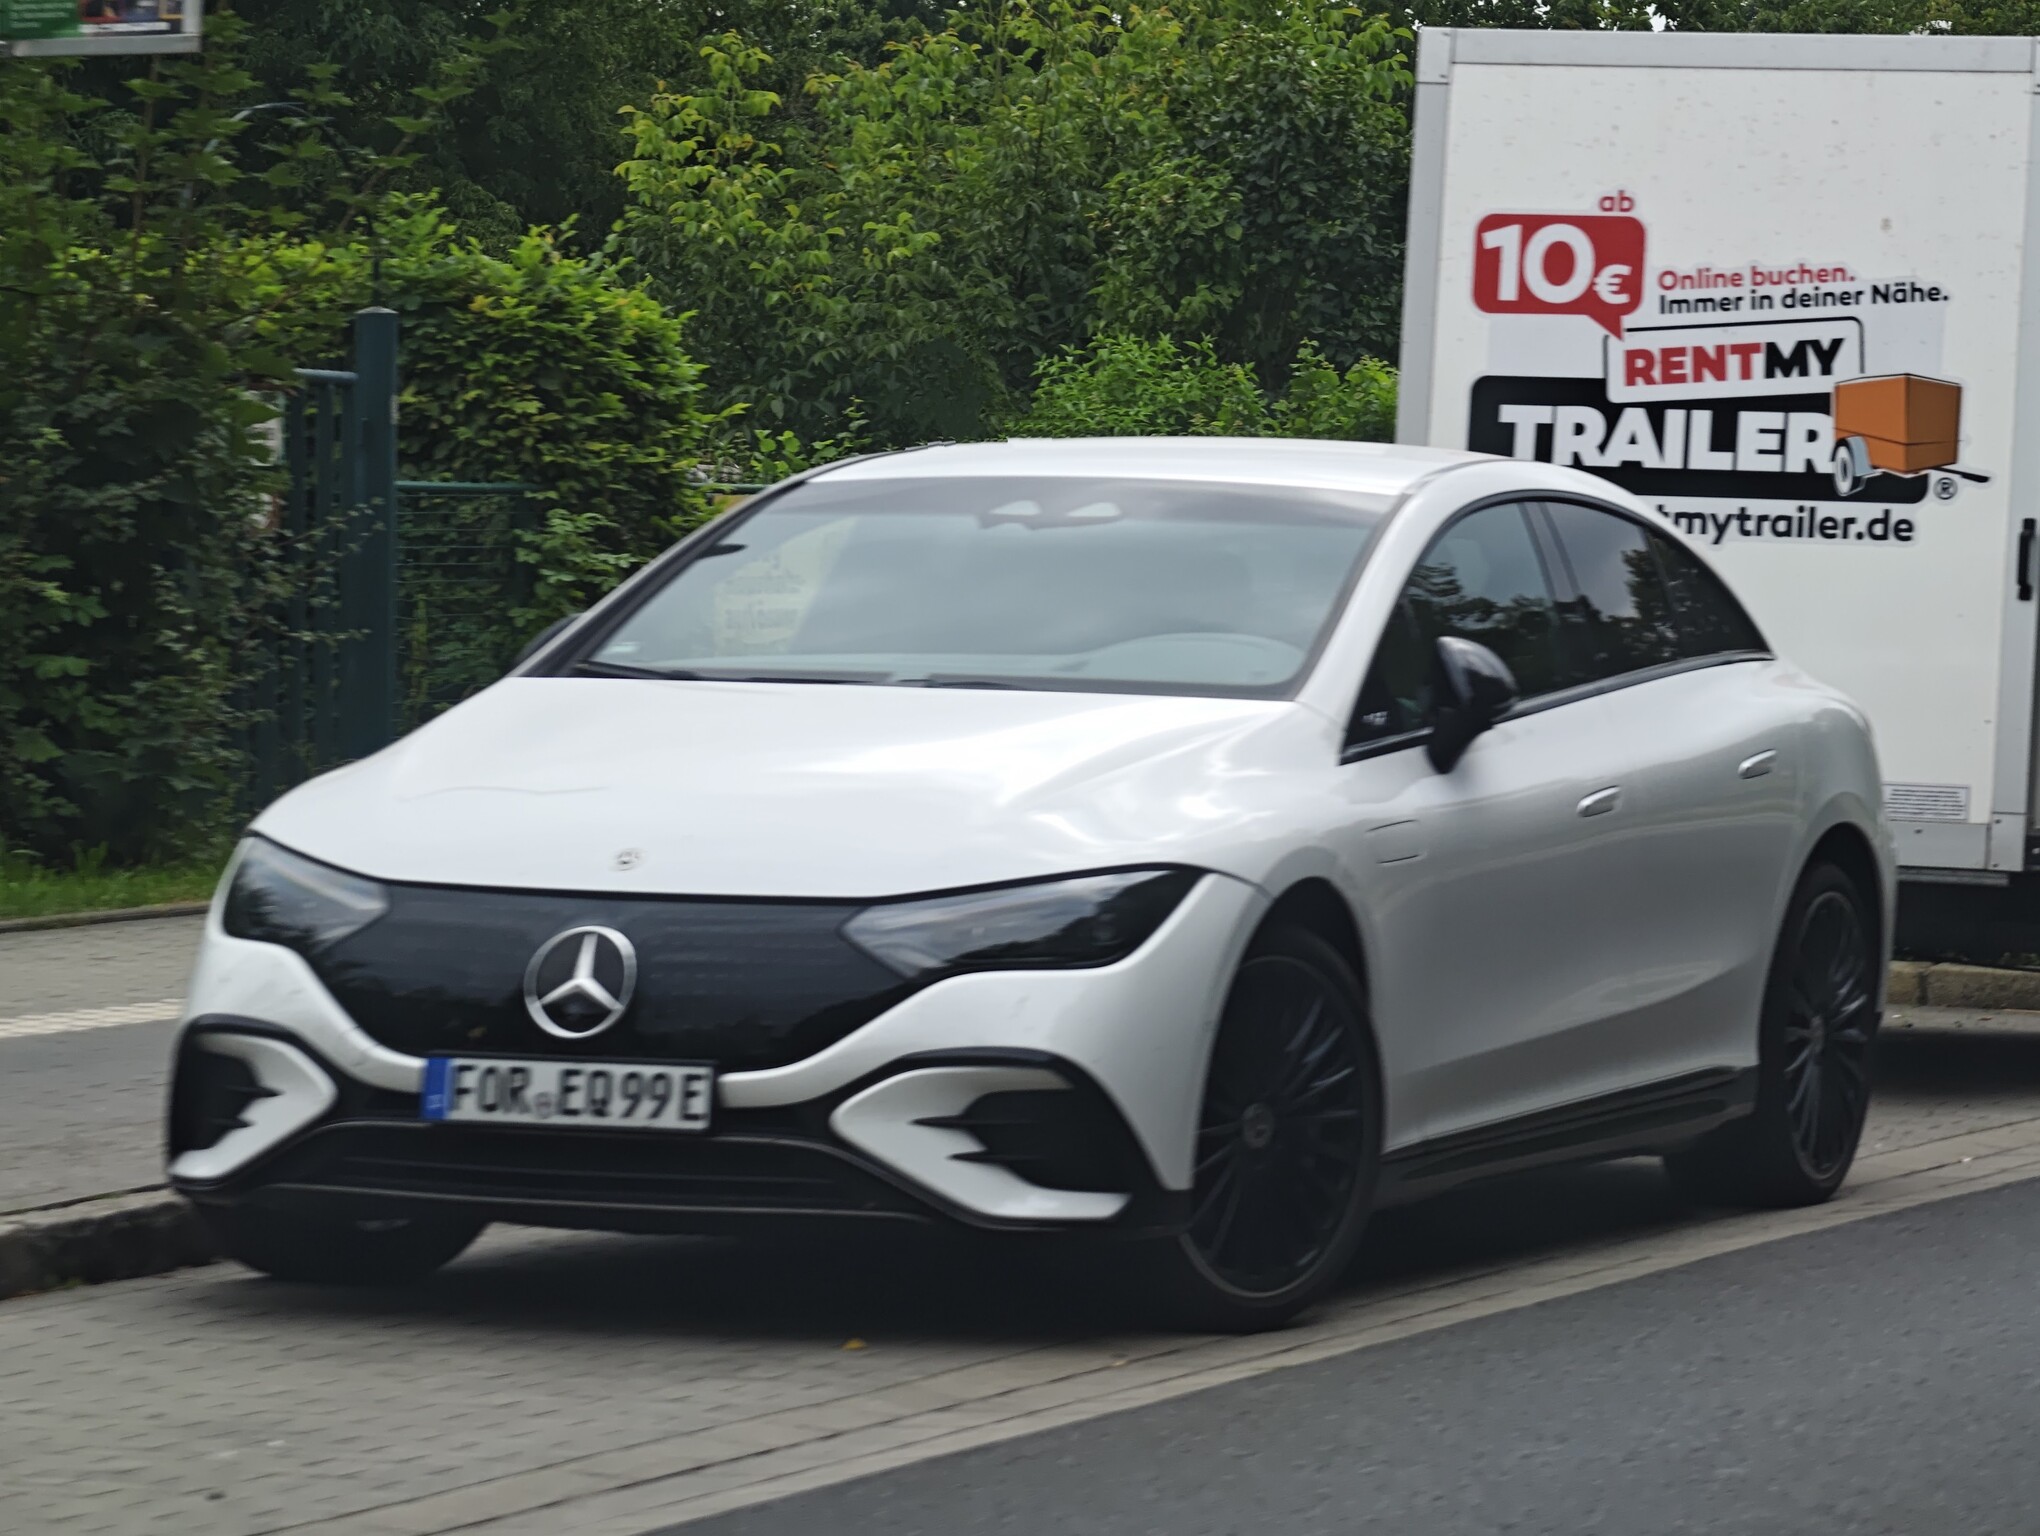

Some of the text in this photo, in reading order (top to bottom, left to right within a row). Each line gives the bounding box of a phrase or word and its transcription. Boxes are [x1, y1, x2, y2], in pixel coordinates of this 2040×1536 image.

[1598, 190, 1635, 213] ab
[1481, 223, 1633, 305] 10€
[1658, 263, 1856, 291] Online buchen.
[1659, 281, 1949, 315] Immer in deiner Nähe.
[1498, 404, 1836, 474] TRAILER
[1657, 504, 1914, 545] mytrailer.de
[453, 1064, 532, 1115] FOR
